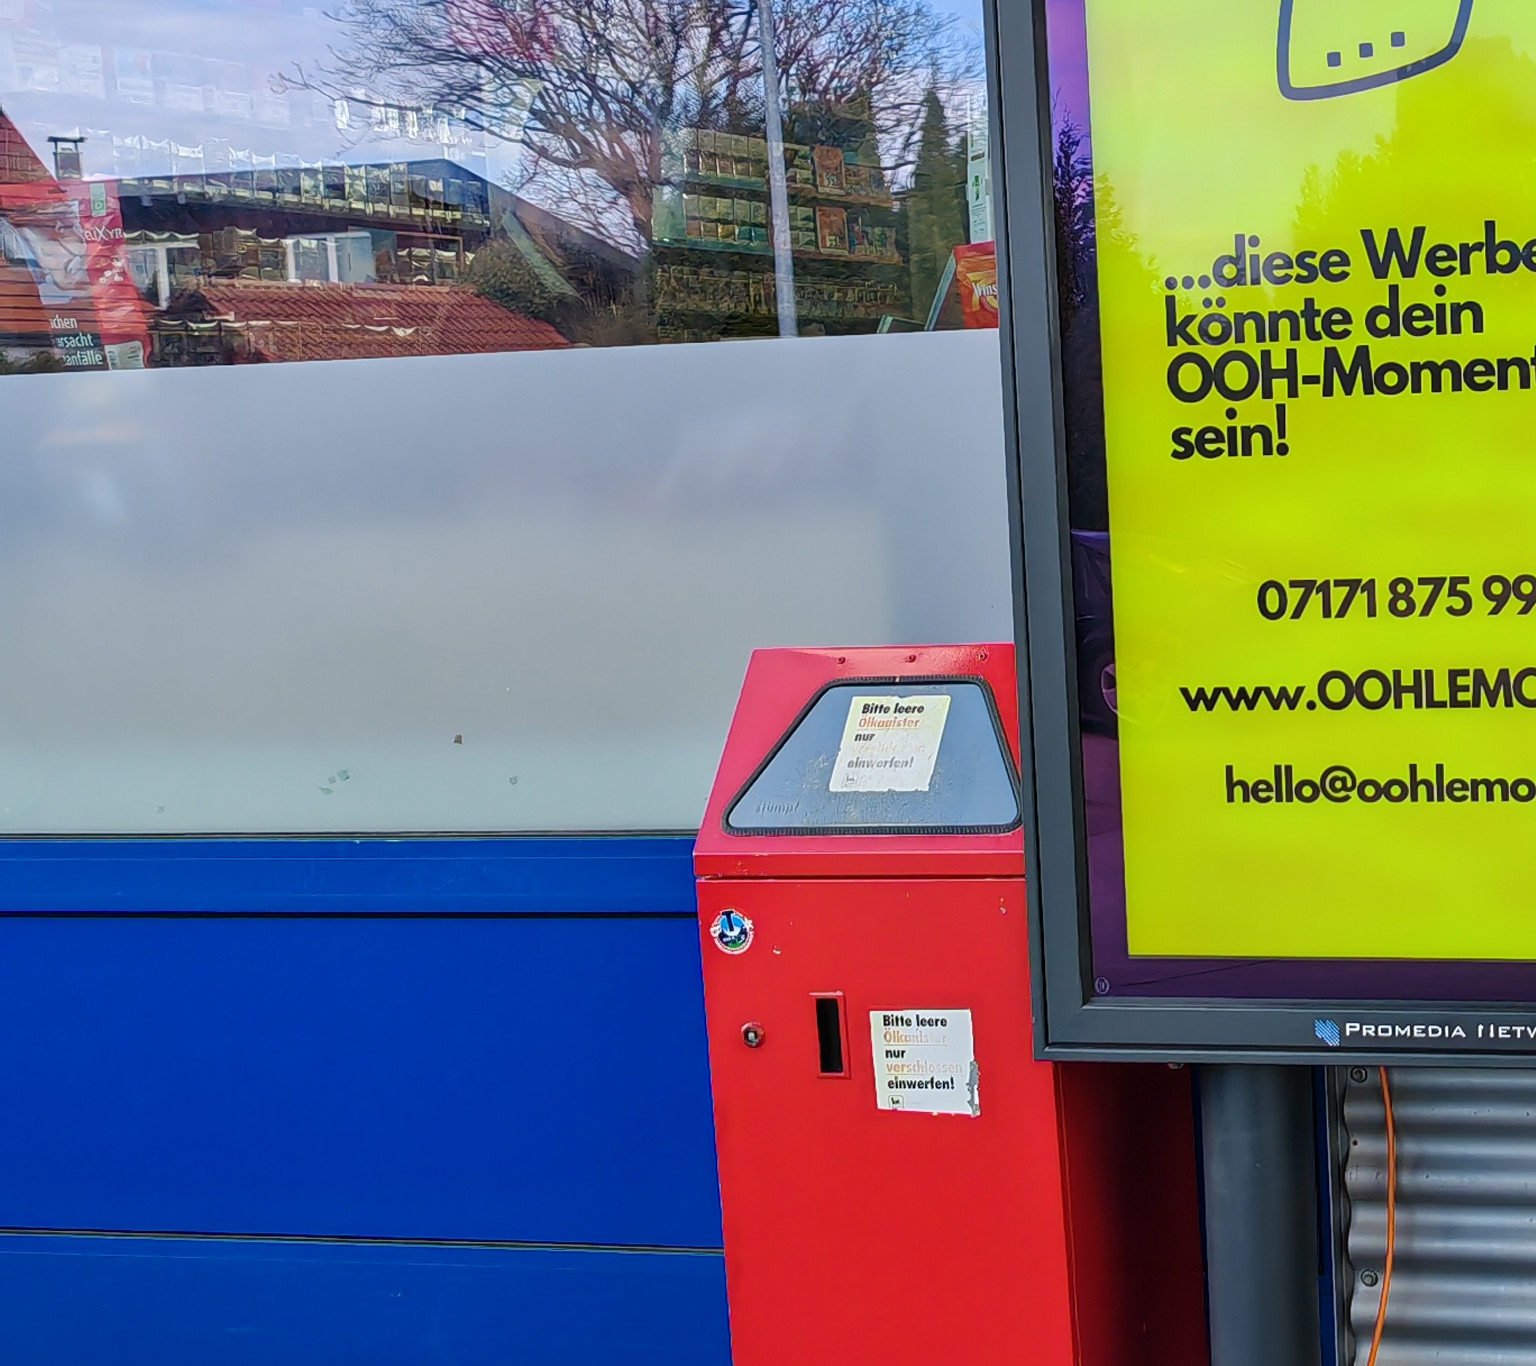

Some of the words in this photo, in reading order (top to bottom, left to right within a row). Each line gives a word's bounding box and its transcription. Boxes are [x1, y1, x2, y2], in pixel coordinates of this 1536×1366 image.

[1164, 233, 1352, 290] ...diese
[1165, 294, 1353, 348] könnte
[1364, 283, 1485, 338] dein
[1170, 402, 1290, 461] sein!
[861, 702, 891, 715] Bitte
[893, 701, 925, 715] leere
[854, 732, 877, 742] nur
[882, 1014, 912, 1027] Bitte
[915, 1014, 948, 1027] leere
[885, 1048, 907, 1059] nur
[887, 1075, 955, 1090] einwerfen!
